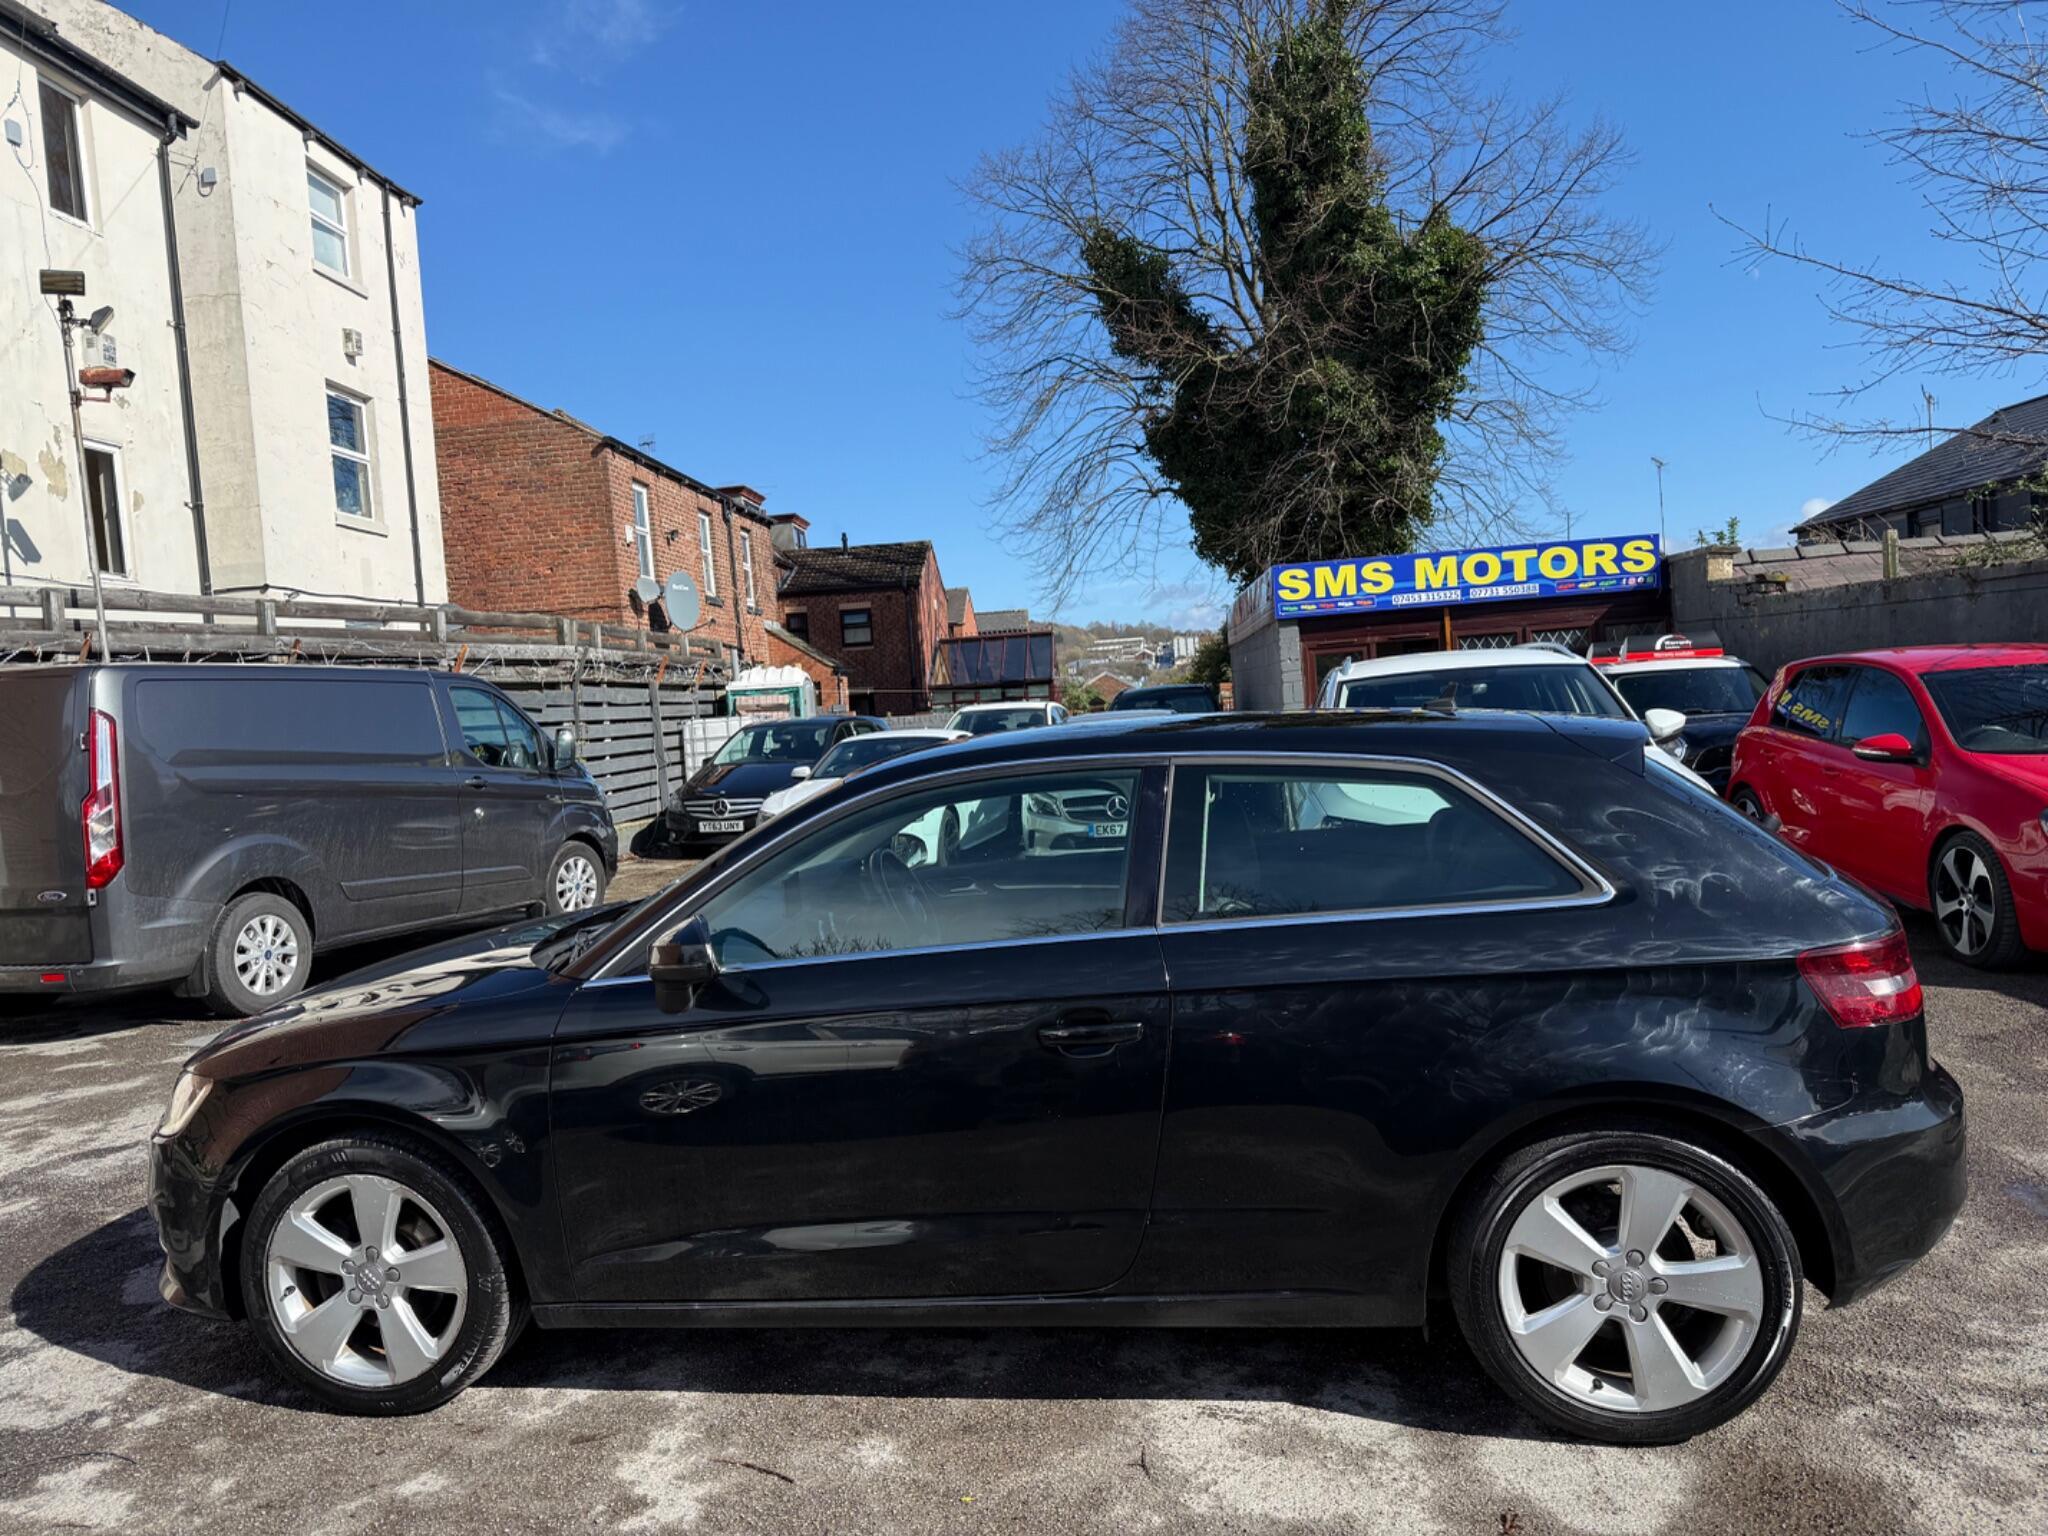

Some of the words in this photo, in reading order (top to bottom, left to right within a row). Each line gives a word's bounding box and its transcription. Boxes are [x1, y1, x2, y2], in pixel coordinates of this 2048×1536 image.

[1278, 561, 1395, 601] SMS
[1414, 540, 1656, 590] MOTORS
[1096, 823, 1124, 836] EK67
